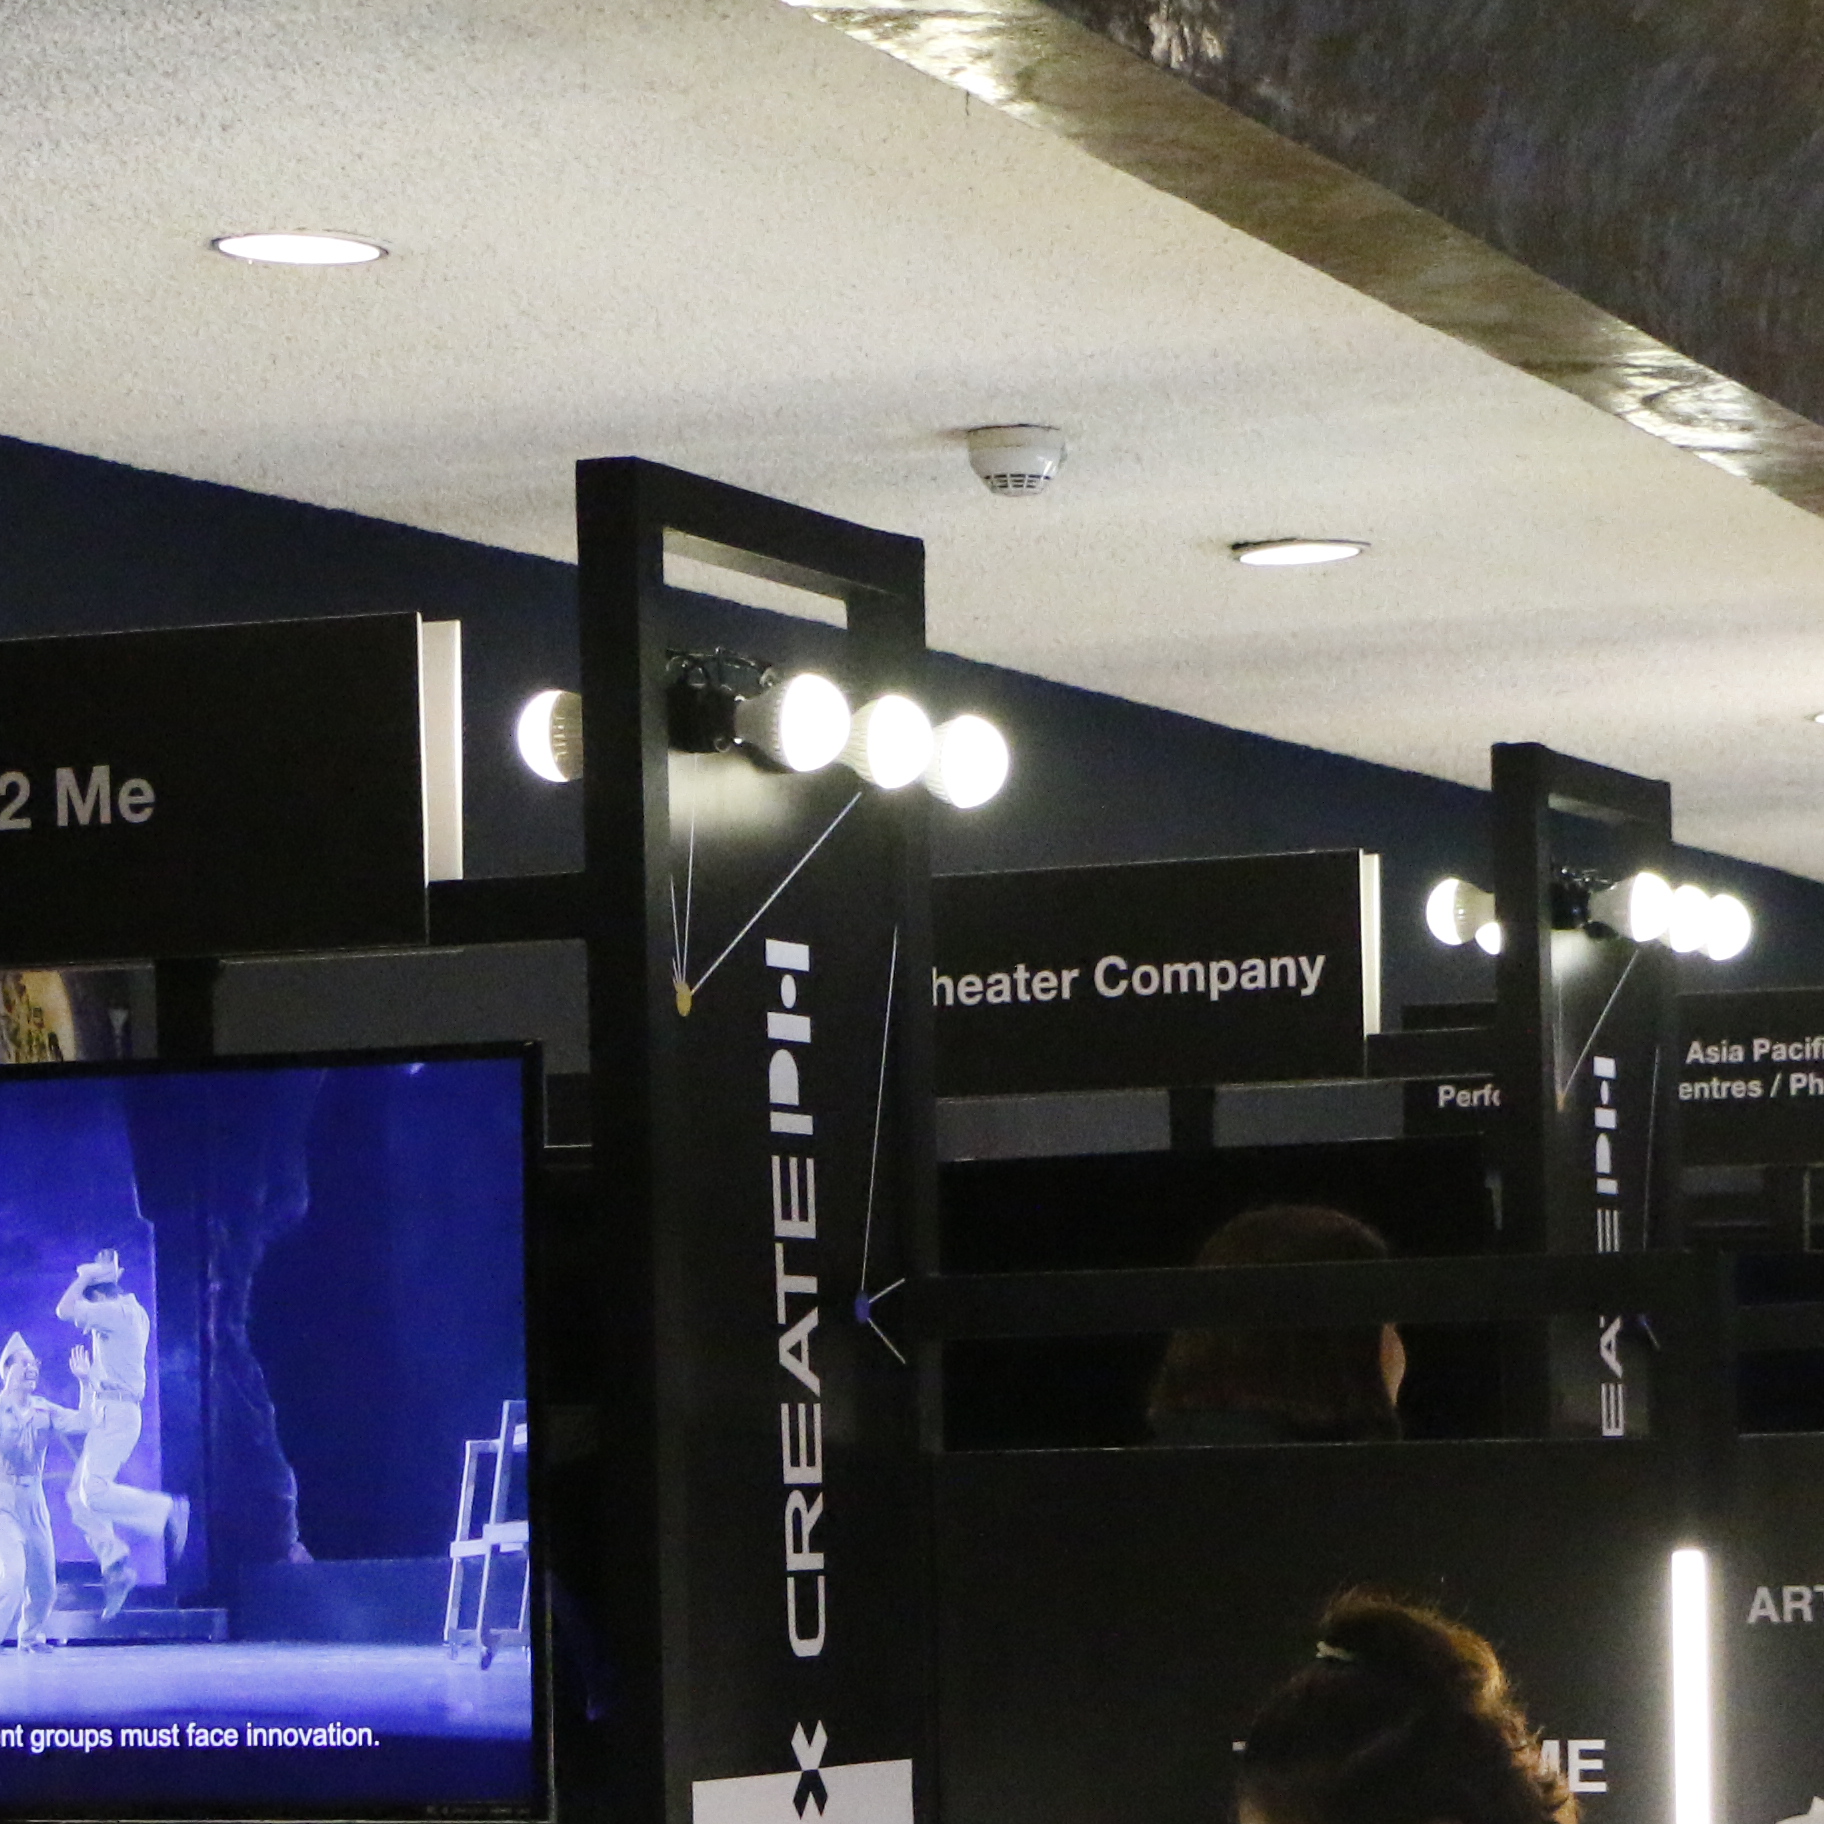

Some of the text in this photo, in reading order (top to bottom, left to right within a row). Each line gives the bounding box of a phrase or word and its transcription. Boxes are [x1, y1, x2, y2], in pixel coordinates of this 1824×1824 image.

[54, 764, 156, 828] Me
[932, 953, 1326, 1006] heater Company
[1684, 1040, 1745, 1065] Asia
[1678, 1076, 1764, 1100] entres
[29, 1727, 113, 1753] groups
[120, 1723, 180, 1747] must
[186, 1722, 239, 1747] face
[246, 1721, 380, 1747] innovation.
